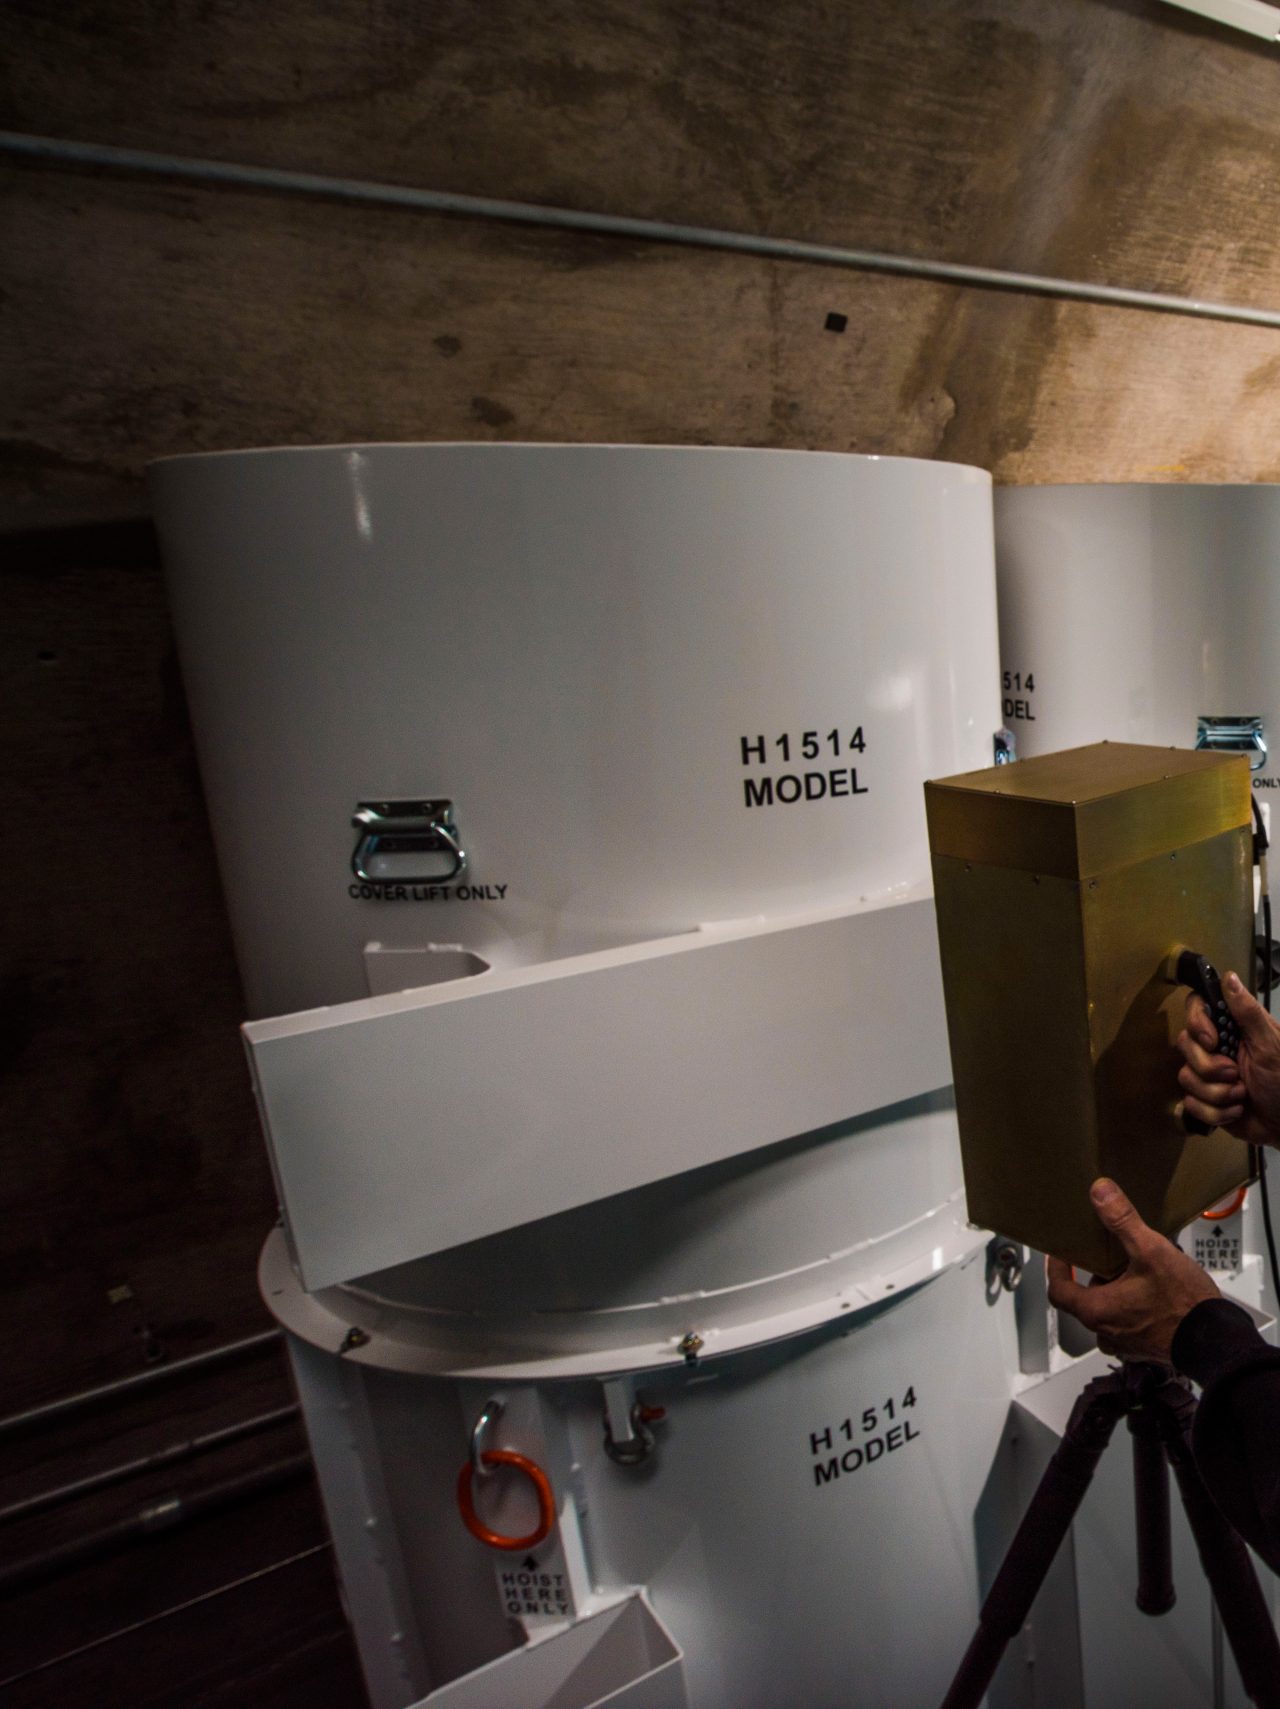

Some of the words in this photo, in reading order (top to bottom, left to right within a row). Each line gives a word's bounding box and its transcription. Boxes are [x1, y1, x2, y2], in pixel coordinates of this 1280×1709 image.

[1003, 671, 1035, 692] 514
[1004, 699, 1035, 720] DEL
[741, 727, 866, 765] H1514
[744, 768, 868, 808] MODEL
[349, 884, 408, 900] COVER
[413, 886, 450, 900] LIFT
[456, 884, 507, 899] ONLY
[1196, 1239, 1239, 1248] HOIST
[1196, 1249, 1238, 1258] HERE
[810, 1386, 917, 1455] H1514
[814, 1421, 920, 1487] MODEL
[502, 1573, 562, 1586] HOIST
[505, 1587, 566, 1600] HERE
[507, 1601, 569, 1615] ONLY
